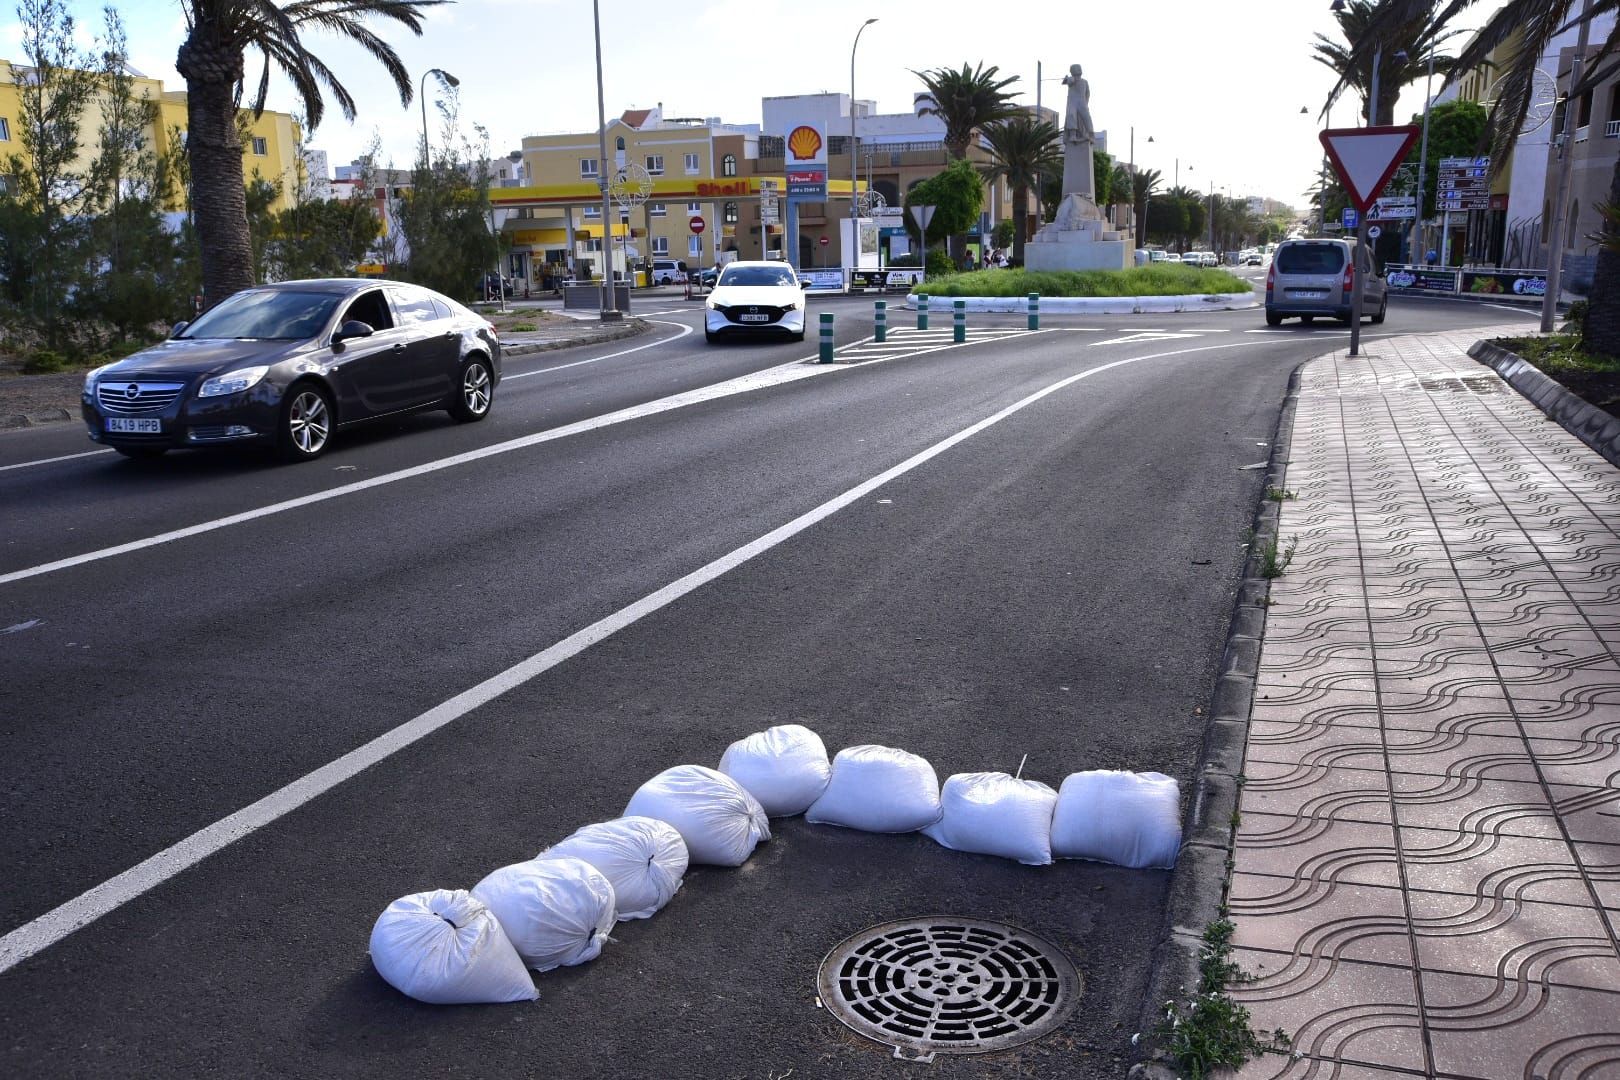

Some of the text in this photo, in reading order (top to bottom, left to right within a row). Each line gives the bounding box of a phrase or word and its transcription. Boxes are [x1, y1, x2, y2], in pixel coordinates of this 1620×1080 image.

[697, 182, 746, 197] Shell
[111, 419, 158, 432] 8419 HPB
